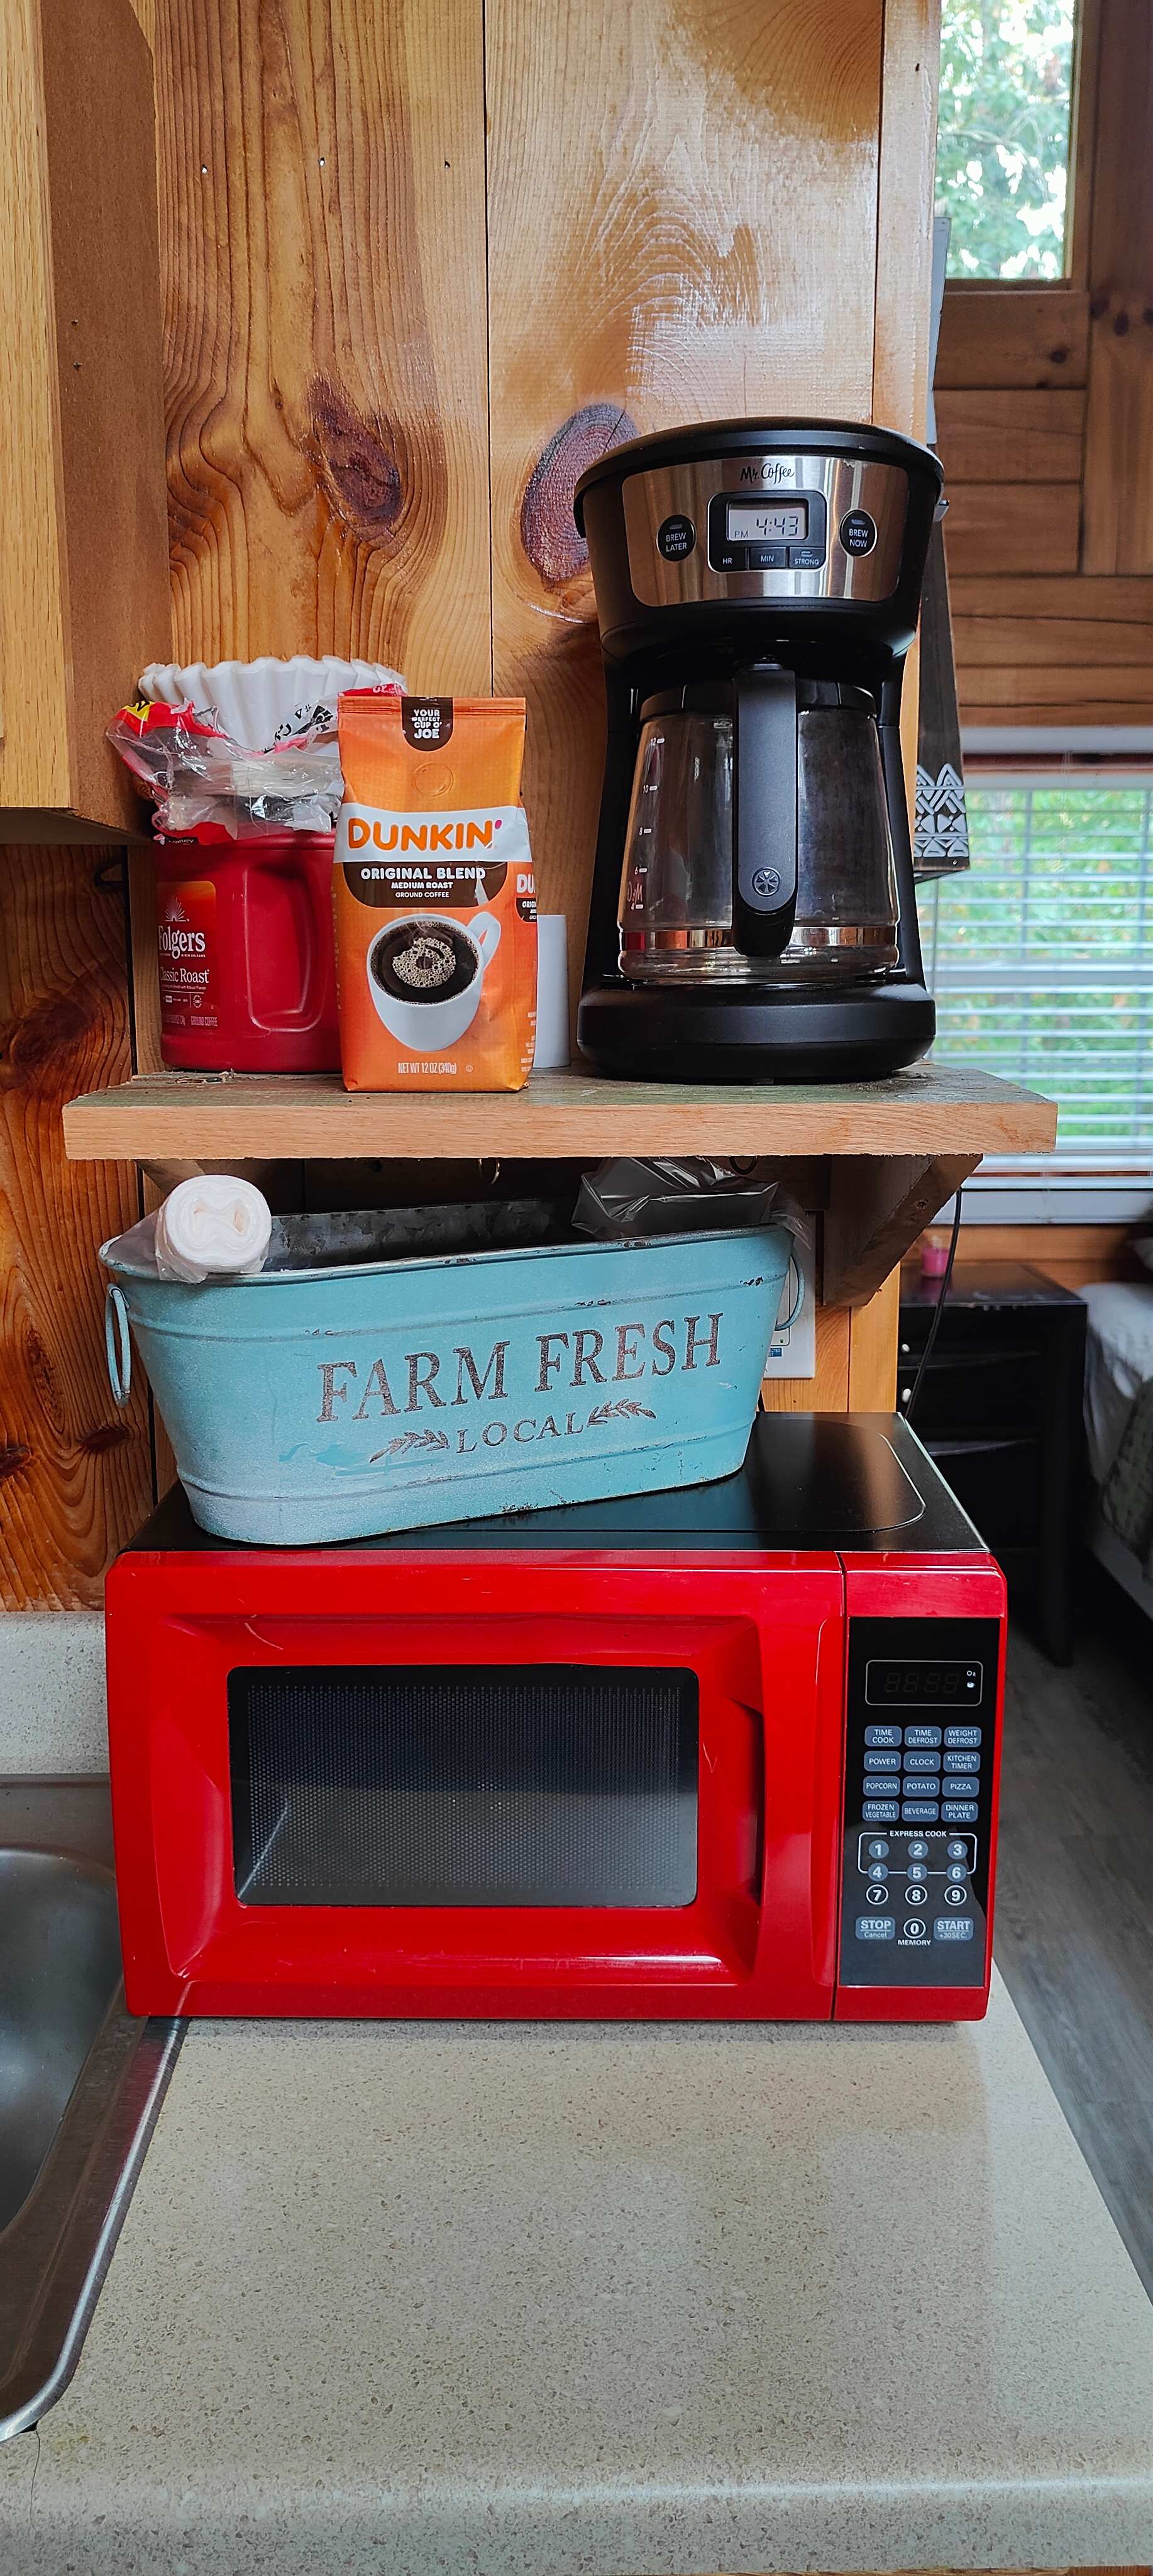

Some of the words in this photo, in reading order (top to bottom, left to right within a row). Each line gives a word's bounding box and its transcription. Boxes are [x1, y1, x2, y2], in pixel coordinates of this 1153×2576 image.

[741, 465, 759, 484] Mr.
[761, 463, 795, 484] Coffee
[756, 516, 798, 536] 4:43
[666, 532, 687, 542] BREW
[849, 528, 868, 538] BREW
[666, 542, 687, 552] LATER
[850, 539, 868, 548] NOW
[760, 555, 775, 563] MIN
[794, 558, 819, 566] STRONG
[414, 709, 440, 717] YOUR
[414, 728, 440, 739] JOE
[650, 737, 656, 746] 12
[643, 784, 649, 793] 10
[348, 818, 502, 852] DUNKIN'
[639, 827, 643, 836] 8
[361, 868, 432, 880] ORIGINAL
[436, 868, 486, 879] BLEND
[634, 866, 638, 875] 6
[517, 874, 536, 894] DU
[158, 926, 206, 959] Folgers
[180, 968, 209, 984] Roast
[397, 1062, 409, 1073] NET
[410, 1062, 421, 1073] WT
[421, 1062, 429, 1073] 12
[429, 1062, 438, 1073] OZ
[438, 1062, 457, 1075] (340g)
[317, 1340, 510, 1423] FARM
[534, 1312, 724, 1392] FRESH
[456, 1411, 584, 1454] LOCAL
[874, 1844, 881, 1855] 1
[913, 1843, 922, 1855] 2
[952, 1844, 962, 1855] 3
[872, 1867, 881, 1878] 4
[912, 1867, 922, 1879] 5
[952, 1867, 961, 1879] 6
[873, 1890, 881, 1901] 7
[912, 1889, 921, 1901] 8
[951, 1890, 961, 1902] 9
[860, 1920, 891, 1929] STOP
[911, 1923, 919, 1935] 0
[937, 1921, 970, 1930] START
